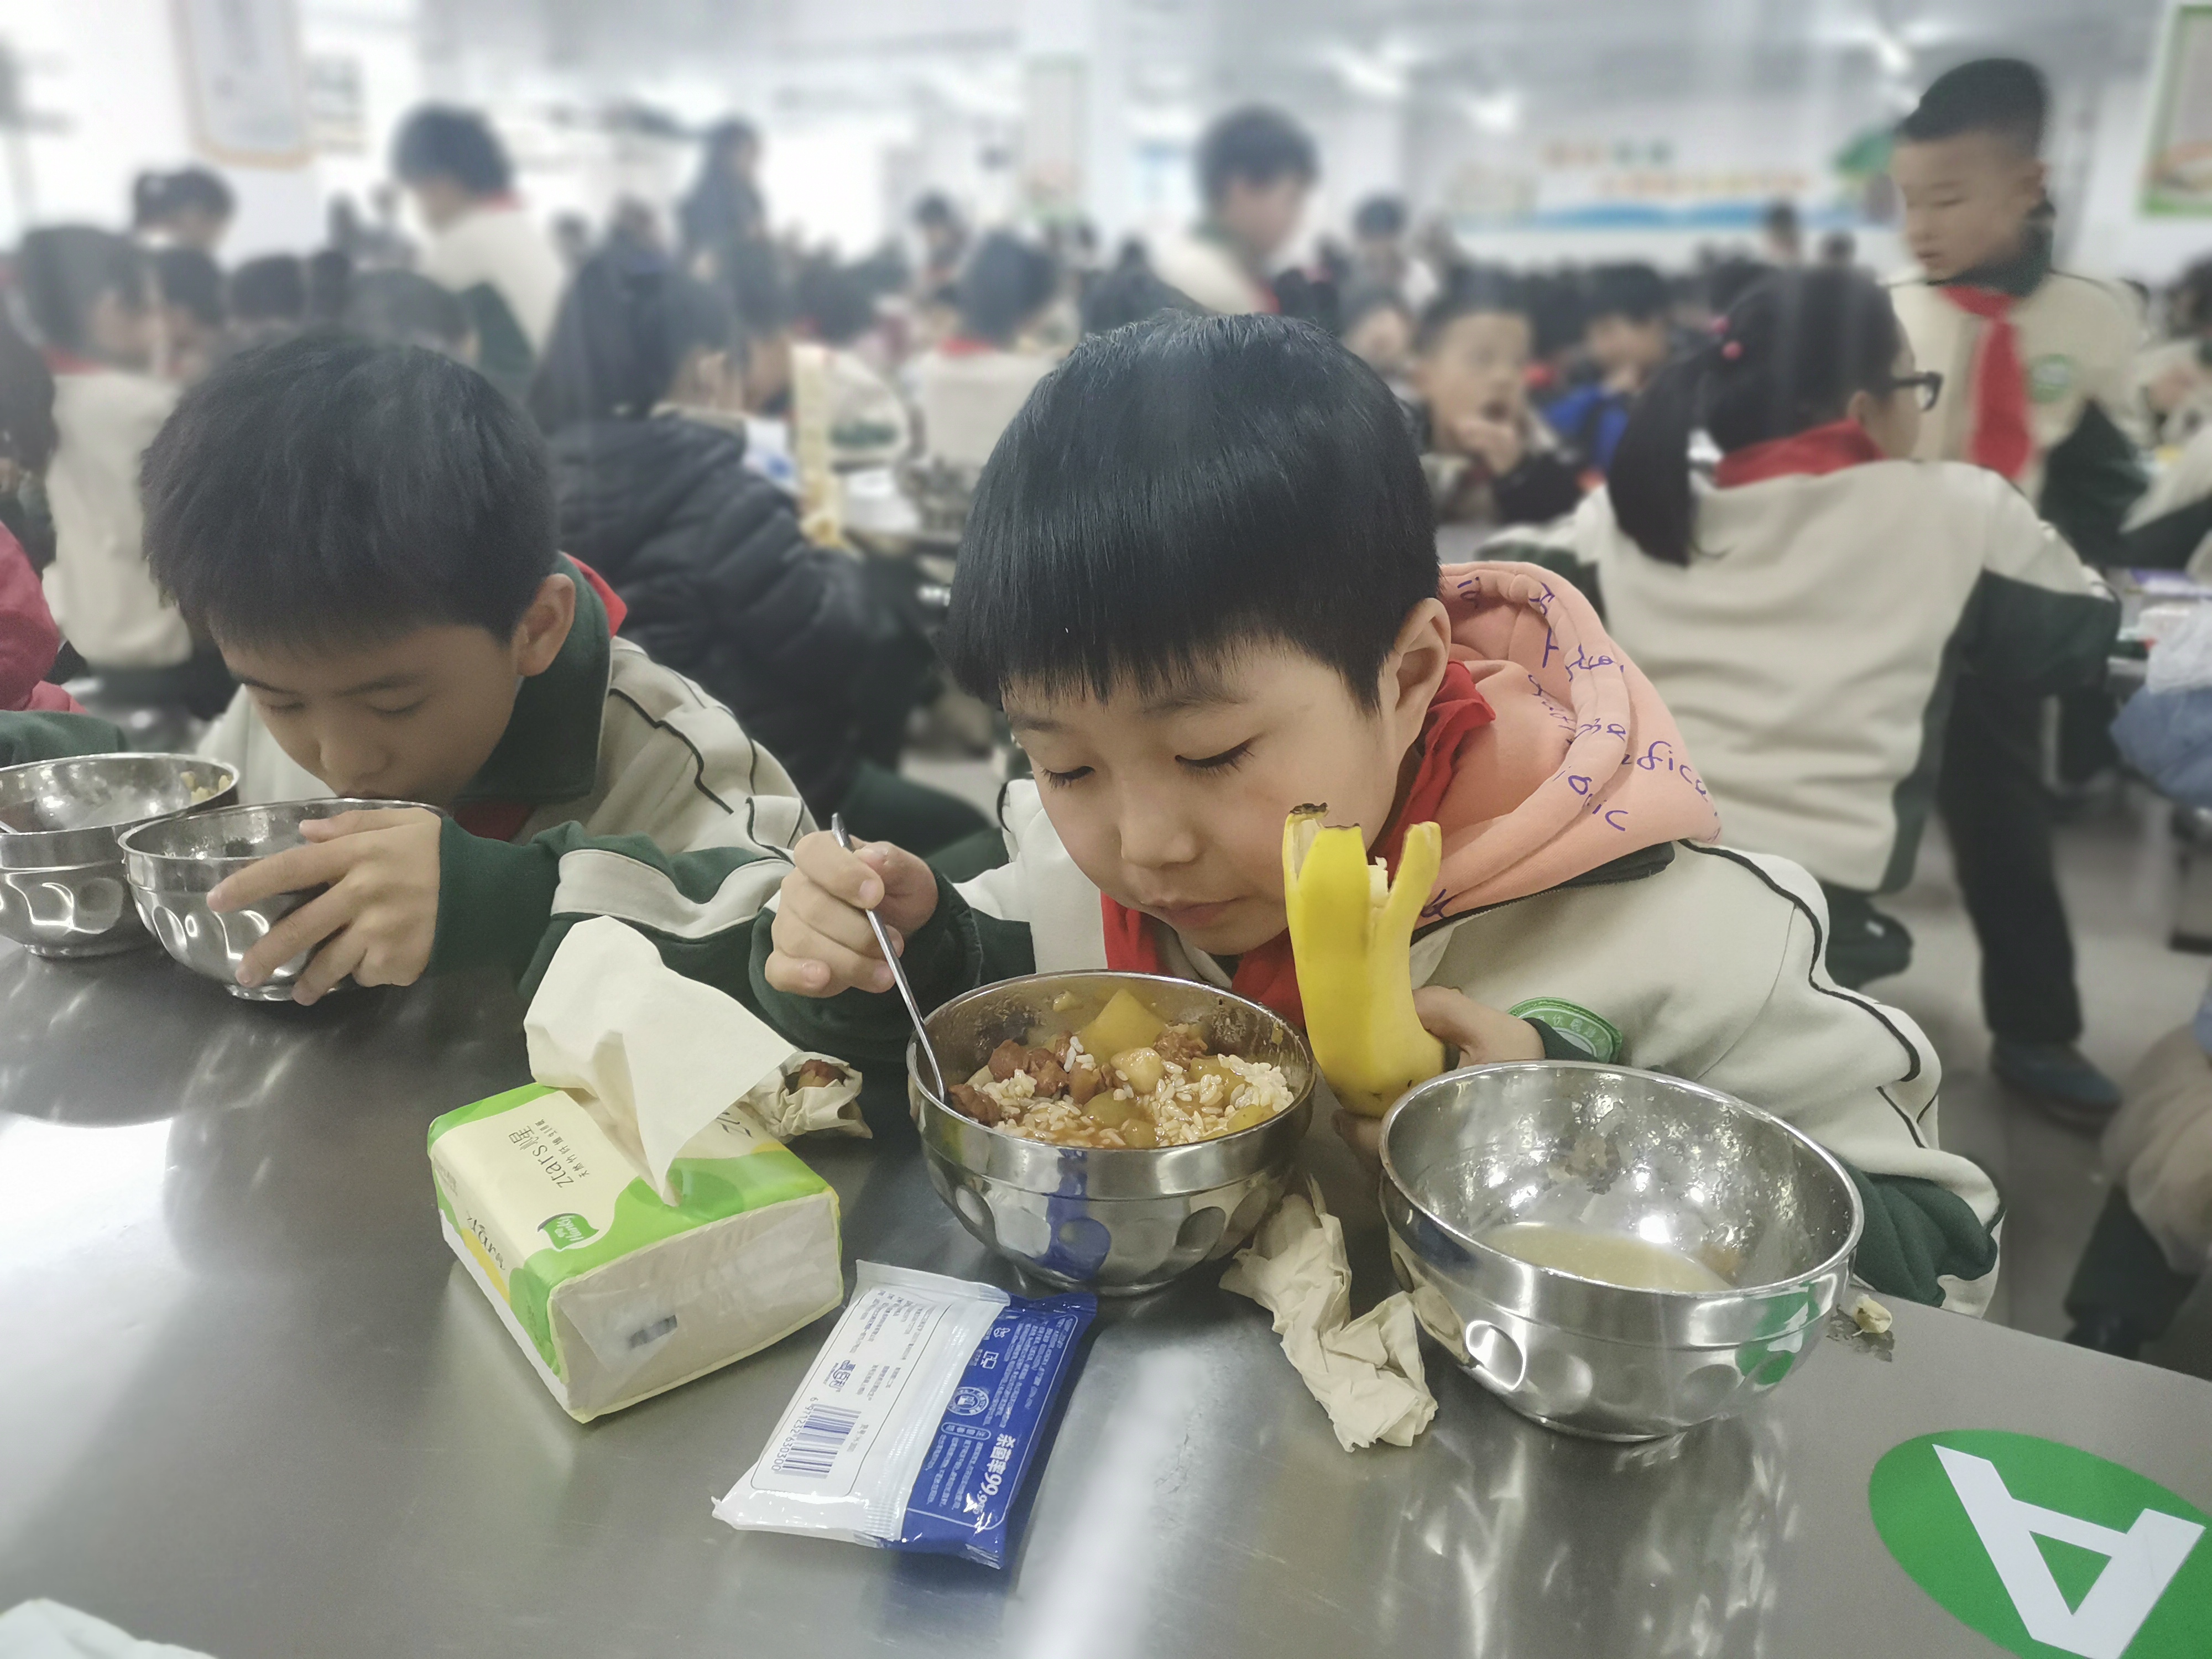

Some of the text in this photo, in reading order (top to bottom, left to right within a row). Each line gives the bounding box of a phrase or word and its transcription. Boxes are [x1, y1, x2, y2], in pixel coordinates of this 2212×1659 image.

[790, 1405, 813, 1433] 971232
[771, 1437, 795, 1471] 630300
[1932, 1444, 2206, 1659] A
